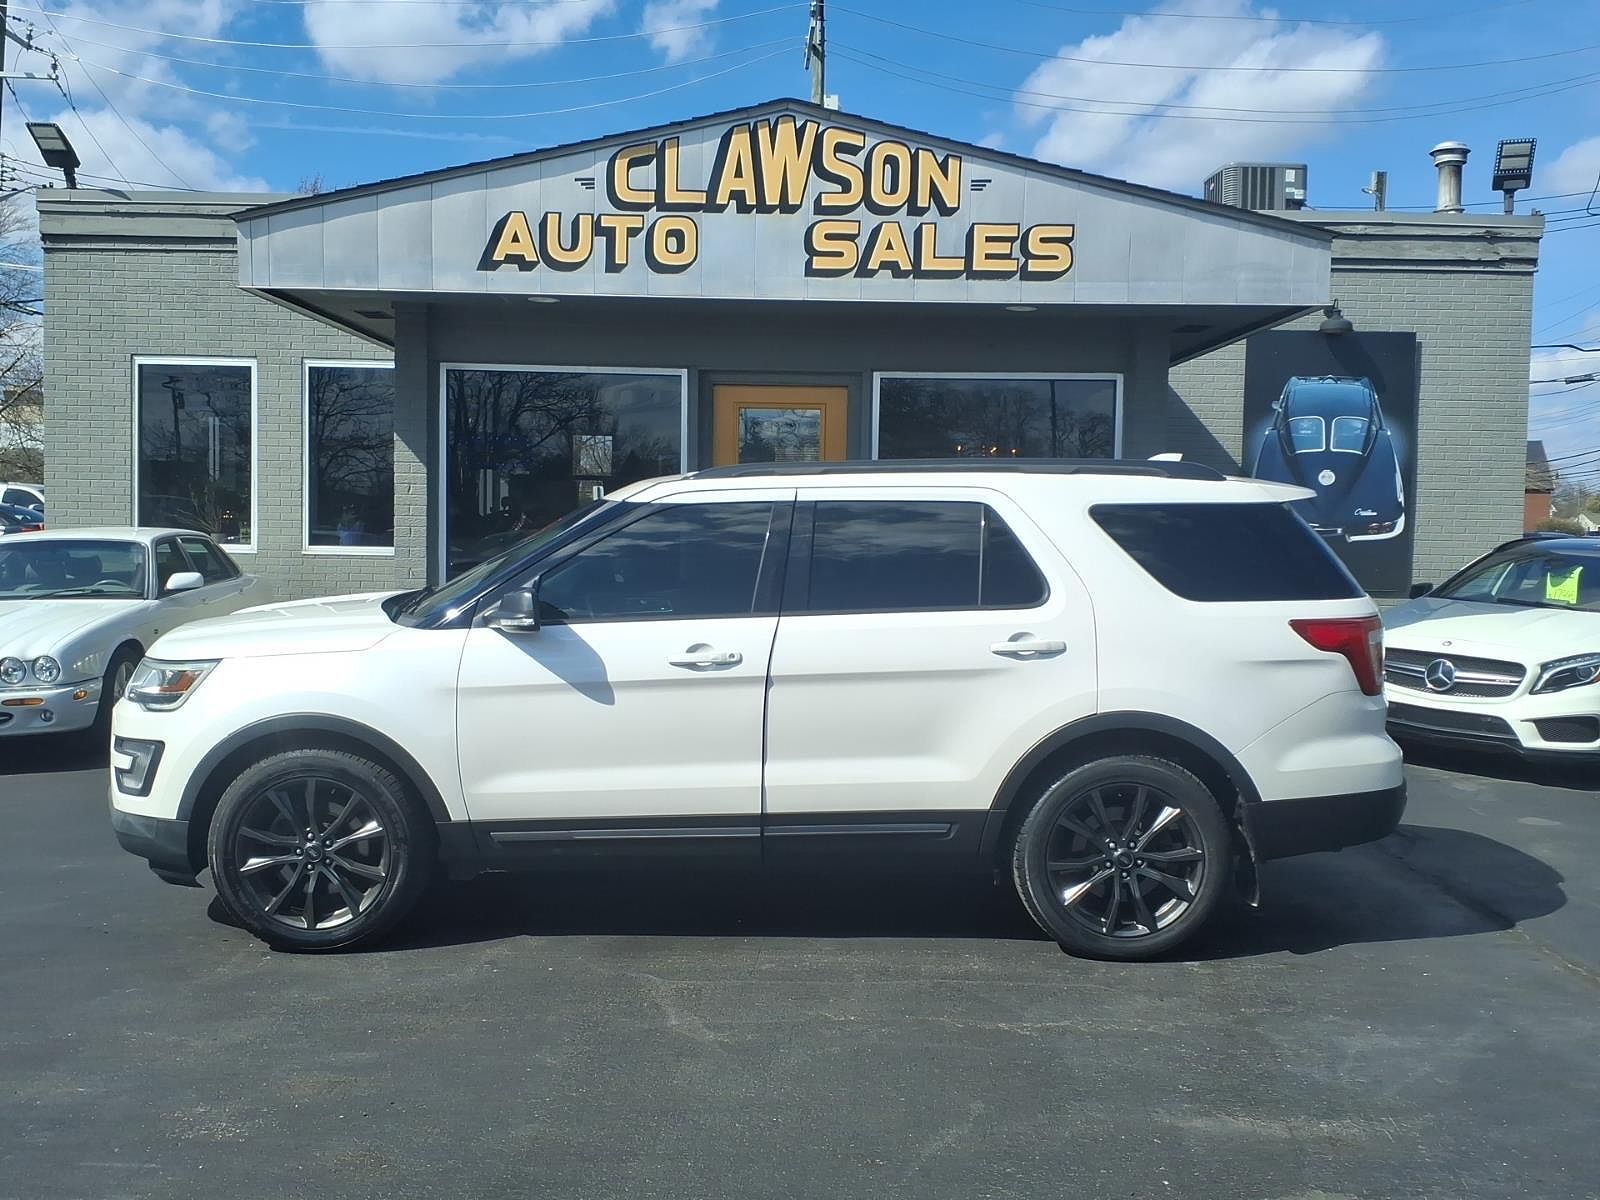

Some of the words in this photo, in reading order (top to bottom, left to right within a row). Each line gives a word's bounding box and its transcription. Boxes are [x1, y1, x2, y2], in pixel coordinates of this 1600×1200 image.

[607, 114, 962, 215] CLAWSON
[478, 210, 698, 273] AUTO
[805, 218, 1075, 280] SALES
